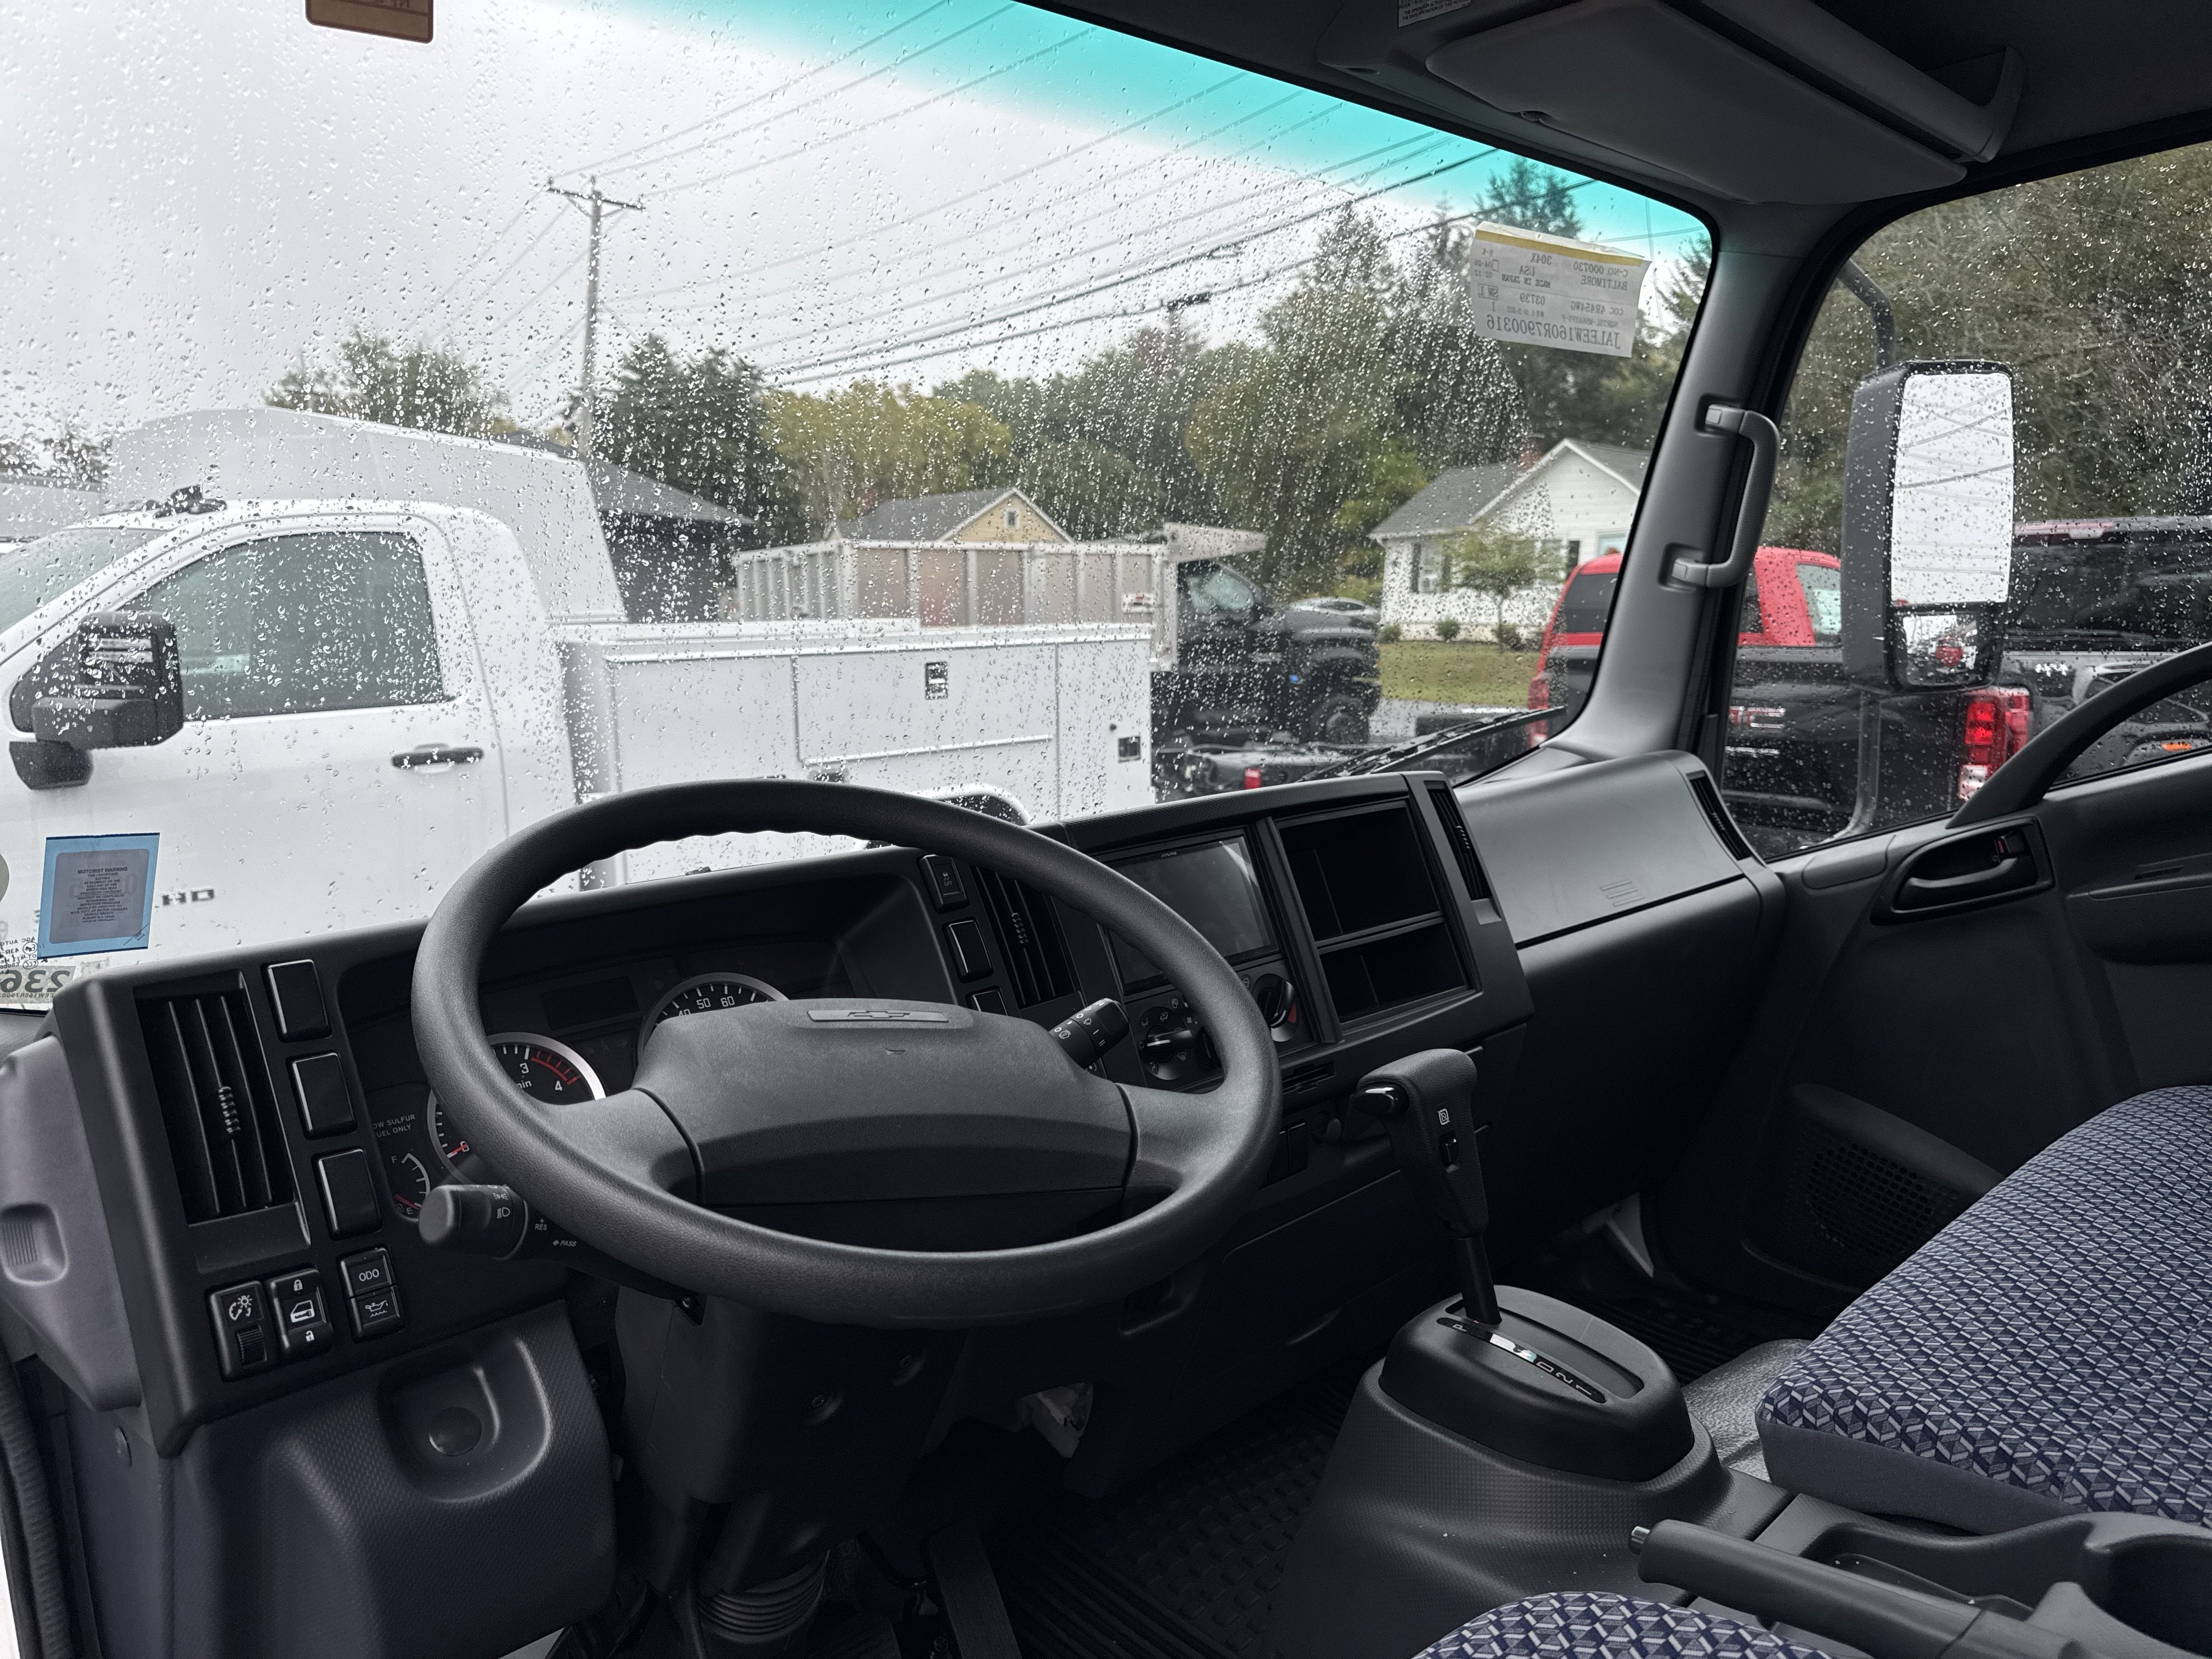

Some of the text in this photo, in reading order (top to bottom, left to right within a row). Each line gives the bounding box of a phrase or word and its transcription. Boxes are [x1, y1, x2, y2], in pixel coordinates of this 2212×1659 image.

[696, 997, 712, 1010] 50
[720, 995, 736, 1008] 60
[520, 1062, 530, 1075] 3
[554, 1080, 563, 1092] 4
[373, 1114, 416, 1130] OW SULFUR
[376, 1124, 411, 1138] UEL ONLY
[391, 1156, 398, 1164] F
[406, 1206, 414, 1216] E
[534, 1223, 548, 1232] RES
[560, 1239, 578, 1248] PASS
[358, 1268, 380, 1283] ODO
[1452, 1324, 1468, 1333] P
[1536, 1361, 1554, 1373] D
[1555, 1372, 1573, 1384] 2
[1576, 1384, 1592, 1396] 1
